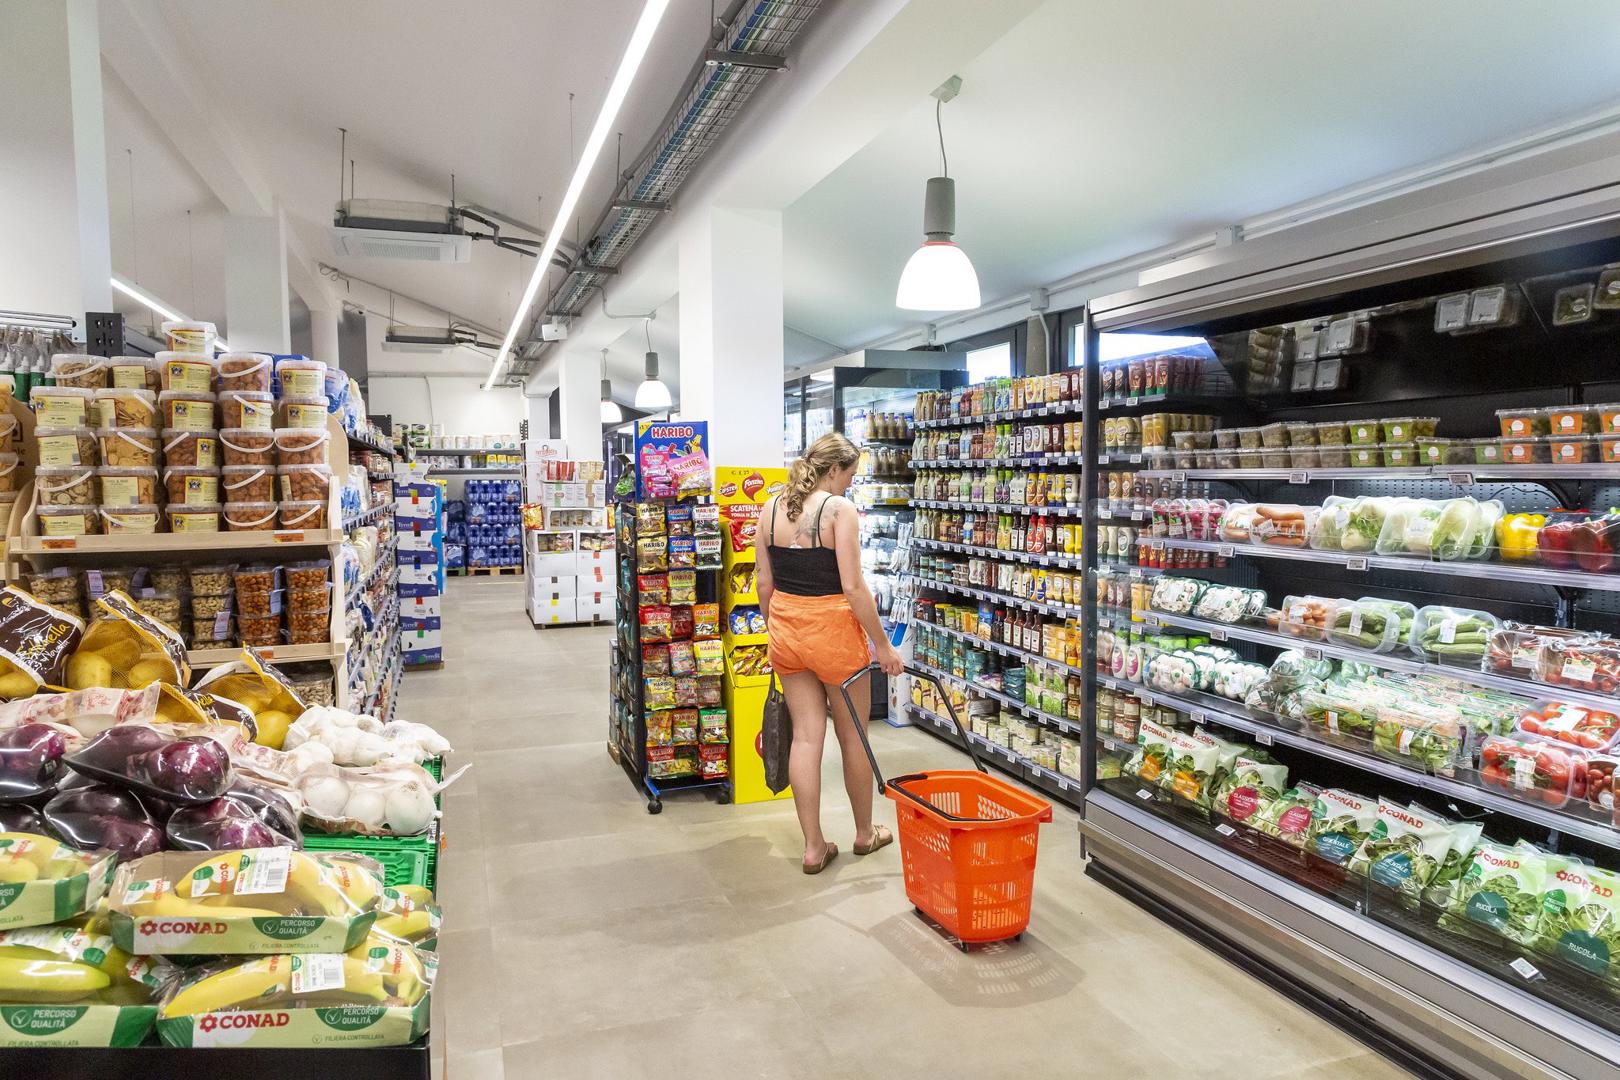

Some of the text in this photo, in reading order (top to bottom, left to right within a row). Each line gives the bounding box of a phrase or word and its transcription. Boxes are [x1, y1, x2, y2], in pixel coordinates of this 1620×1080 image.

[652, 426, 693, 438] HARIBO
[730, 504, 759, 512] SCATENA
[1147, 726, 1167, 739] CONAD
[1328, 793, 1362, 811] CONAD
[1386, 809, 1424, 829] CONAD
[1483, 853, 1520, 870] CONAD
[1475, 903, 1498, 915] RUCOLA
[159, 921, 228, 935] CONAD
[280, 919, 316, 927] PERCORSO
[278, 927, 308, 935] QUALITÀ
[1567, 942, 1600, 960] RUCOLA
[33, 1009, 77, 1019] PERCORSO
[343, 1007, 379, 1015] PERCORSO
[30, 1018, 66, 1029] QUALITÀ
[219, 1013, 290, 1029] CONAD
[341, 1016, 371, 1025] QUALITÀ
